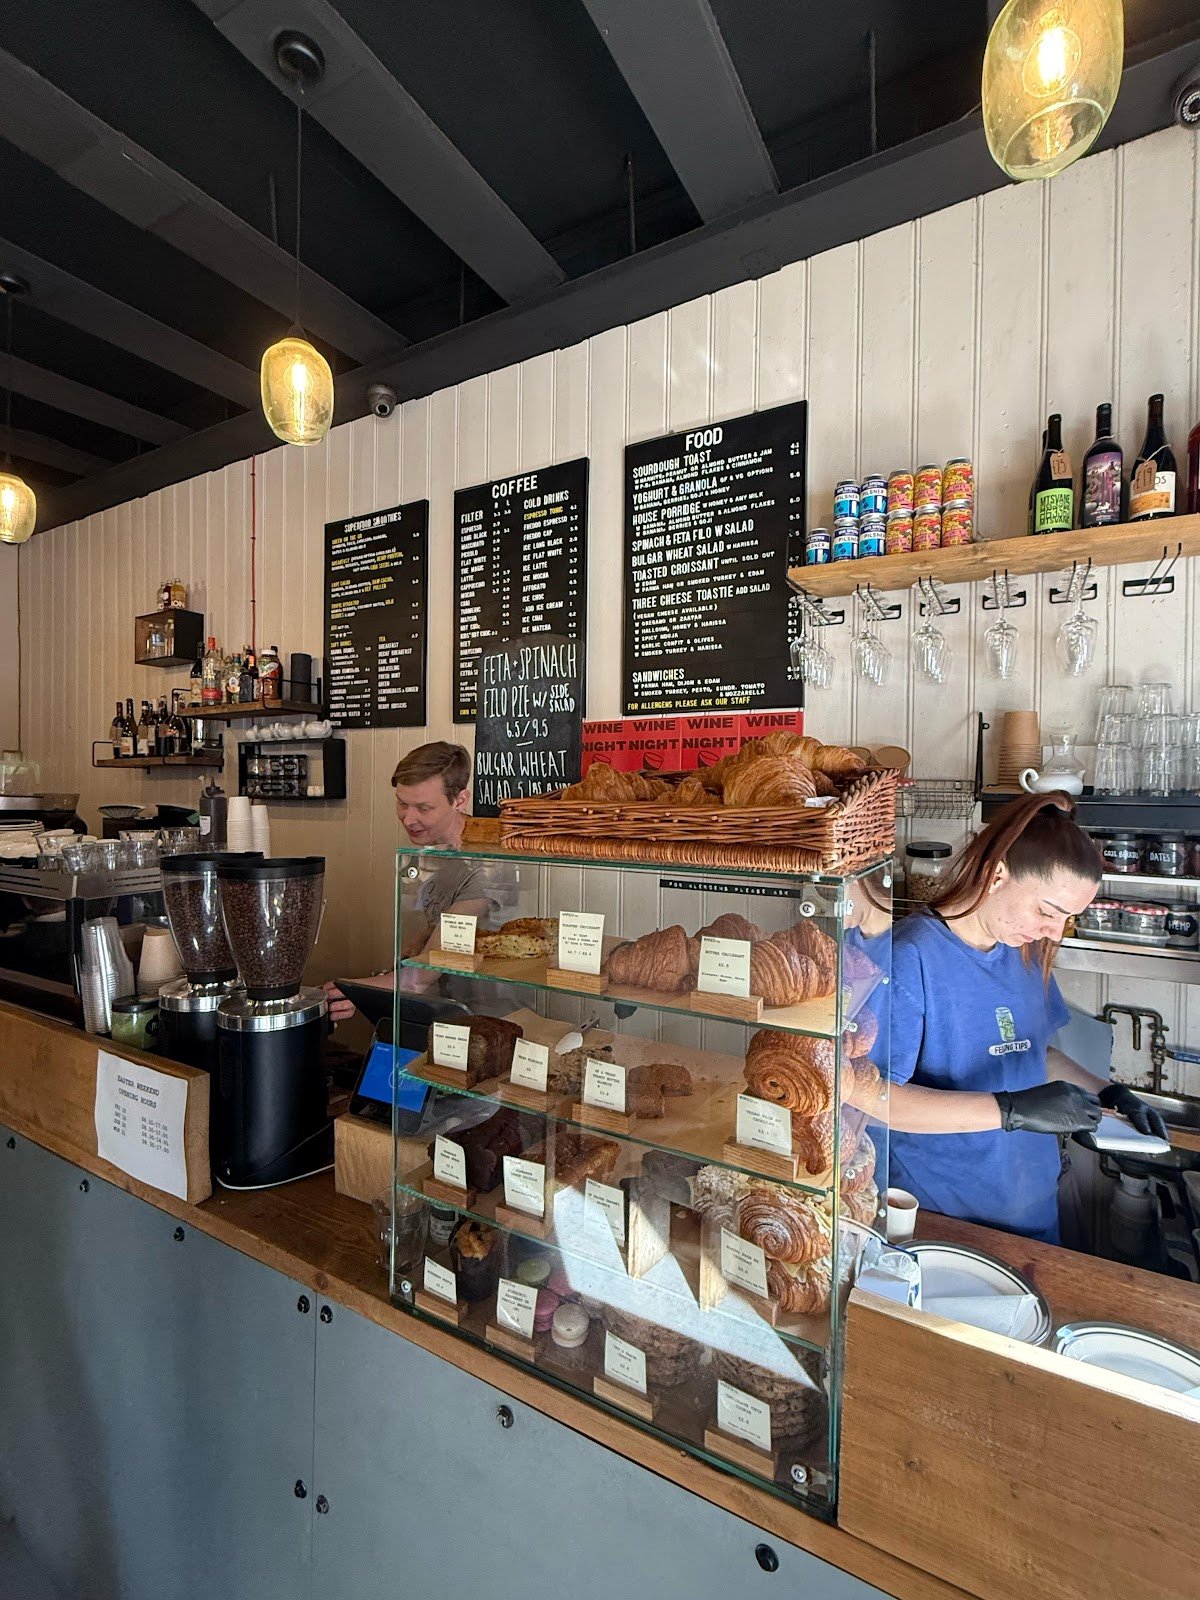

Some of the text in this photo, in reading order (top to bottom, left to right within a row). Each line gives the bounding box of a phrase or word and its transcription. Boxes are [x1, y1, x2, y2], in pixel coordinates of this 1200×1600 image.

[686, 427, 723, 451] FOOD
[633, 450, 711, 479] SOURDOUGH TOAST
[492, 475, 538, 498] COFFEE
[633, 488, 668, 505] YOGHURT
[672, 486, 677, 496] &
[679, 477, 717, 495] GRANOLA
[747, 467, 773, 477] OPTIONS
[524, 490, 569, 509] COLD DRINKS
[1040, 494, 1069, 505] MTSVANE
[633, 511, 658, 526] HOUSE
[661, 502, 700, 520] PORRIDGE
[708, 498, 728, 508] HONEY
[749, 491, 763, 500] MILK
[461, 510, 483, 524] FILTER
[543, 529, 552, 537] CAP
[632, 519, 754, 552] SPINACH & FETA FILO W SALAD
[533, 541, 545, 549] LONG
[547, 538, 563, 546] BLACK
[533, 551, 545, 559] FLAT
[547, 548, 562, 557] WHITE
[632, 551, 663, 568] BULGAR
[666, 545, 693, 561] WHEAT
[696, 540, 724, 556] SALAD
[733, 540, 759, 549] HARISSA
[533, 561, 547, 570] LATTE
[632, 566, 667, 582] TOASTED
[671, 557, 719, 576] CROISSANT
[721, 557, 738, 565] UNTIL
[742, 553, 758, 562] SOLD
[687, 577, 710, 586] SMOKED
[713, 573, 736, 582] TURKEY
[748, 569, 764, 577] EDAM
[632, 582, 770, 610] THREE CHEESE TOASTIE ADD SALAD
[657, 607, 678, 617] CHEESE
[682, 604, 718, 614] AVAILABLE)
[673, 623, 691, 631] HONEY
[702, 619, 726, 627] HARISSA
[642, 641, 660, 649] GARLIC
[664, 639, 683, 647] CONFIT
[694, 636, 714, 644] OLIVES
[642, 649, 662, 657] SMOKED
[697, 643, 722, 651] HARISSA
[484, 652, 511, 685] FETA
[518, 644, 576, 681] SPINACH
[633, 668, 685, 683] SANDWICHES
[725, 689, 765, 697] MOZZARELLA
[484, 687, 507, 719] FILO
[512, 684, 530, 718] PIE
[533, 691, 547, 708] W/
[550, 683, 569, 698] SIDE
[549, 699, 575, 713] SALAD
[628, 702, 638, 710] FOR
[641, 700, 672, 709] ALLERGENS
[675, 699, 697, 708] PLEASE
[701, 699, 712, 707] ASK
[731, 697, 750, 705] STAFF
[633, 720, 676, 731] WINE
[687, 717, 733, 729] WINE
[745, 715, 797, 727] WINE
[584, 723, 623, 734] WINE
[582, 740, 626, 751] NIGHT
[629, 738, 679, 750] NIGHT
[682, 737, 737, 748] NIGHT
[477, 750, 567, 778] BULGAR WHEAT
[1150, 852, 1170, 862] DATES
[735, 887, 766, 895] PLEASE
[1169, 921, 1190, 930] HEMP
[1014, 1042, 1028, 1050] TIPS
[118, 1075, 159, 1096] EASTER WEEKEND
[119, 1088, 156, 1108] OPENING HOURS
